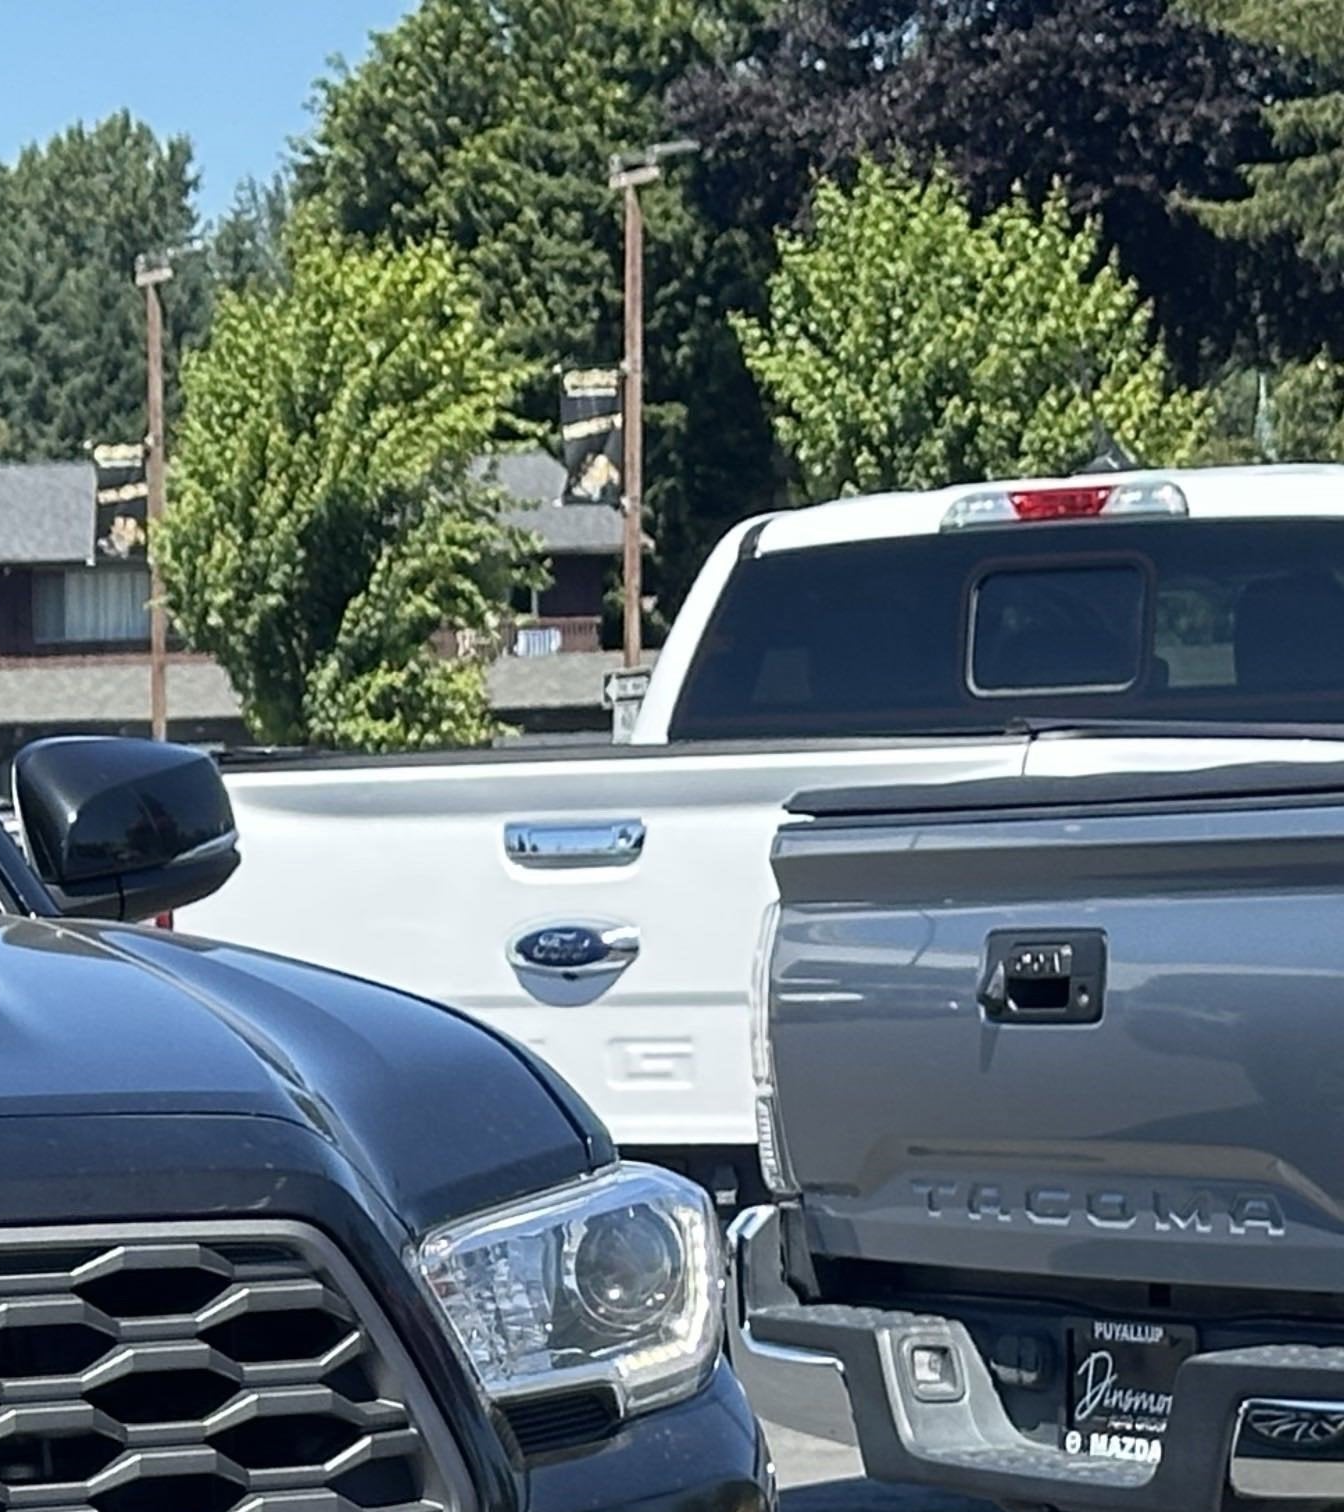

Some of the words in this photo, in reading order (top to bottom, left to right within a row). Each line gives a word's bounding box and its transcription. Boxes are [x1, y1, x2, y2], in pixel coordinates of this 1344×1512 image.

[911, 1179, 1286, 1236] TACOMA
[1094, 1321, 1164, 1343] PUYALLUP
[1075, 1351, 1173, 1421] Dinsmor
[1089, 1432, 1162, 1464] MAZDA
